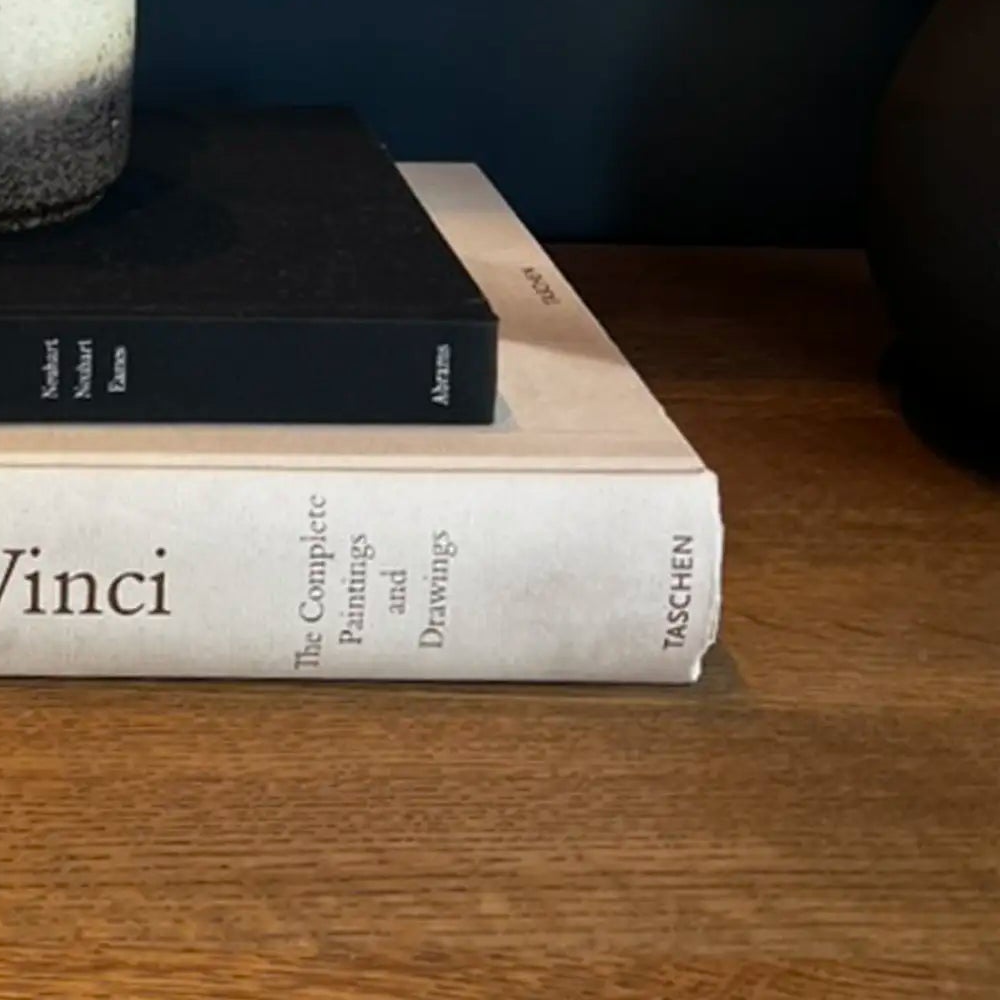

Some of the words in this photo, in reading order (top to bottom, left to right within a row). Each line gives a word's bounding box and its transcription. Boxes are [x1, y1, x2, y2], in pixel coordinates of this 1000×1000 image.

[430, 343, 451, 406] Abrams
[300, 494, 334, 624] Complete
[338, 534, 376, 645] Paintings
[380, 570, 407, 615] and
[418, 530, 458, 649] Drawings
[662, 534, 694, 650] TASCHEN
[294, 632, 323, 670] The
